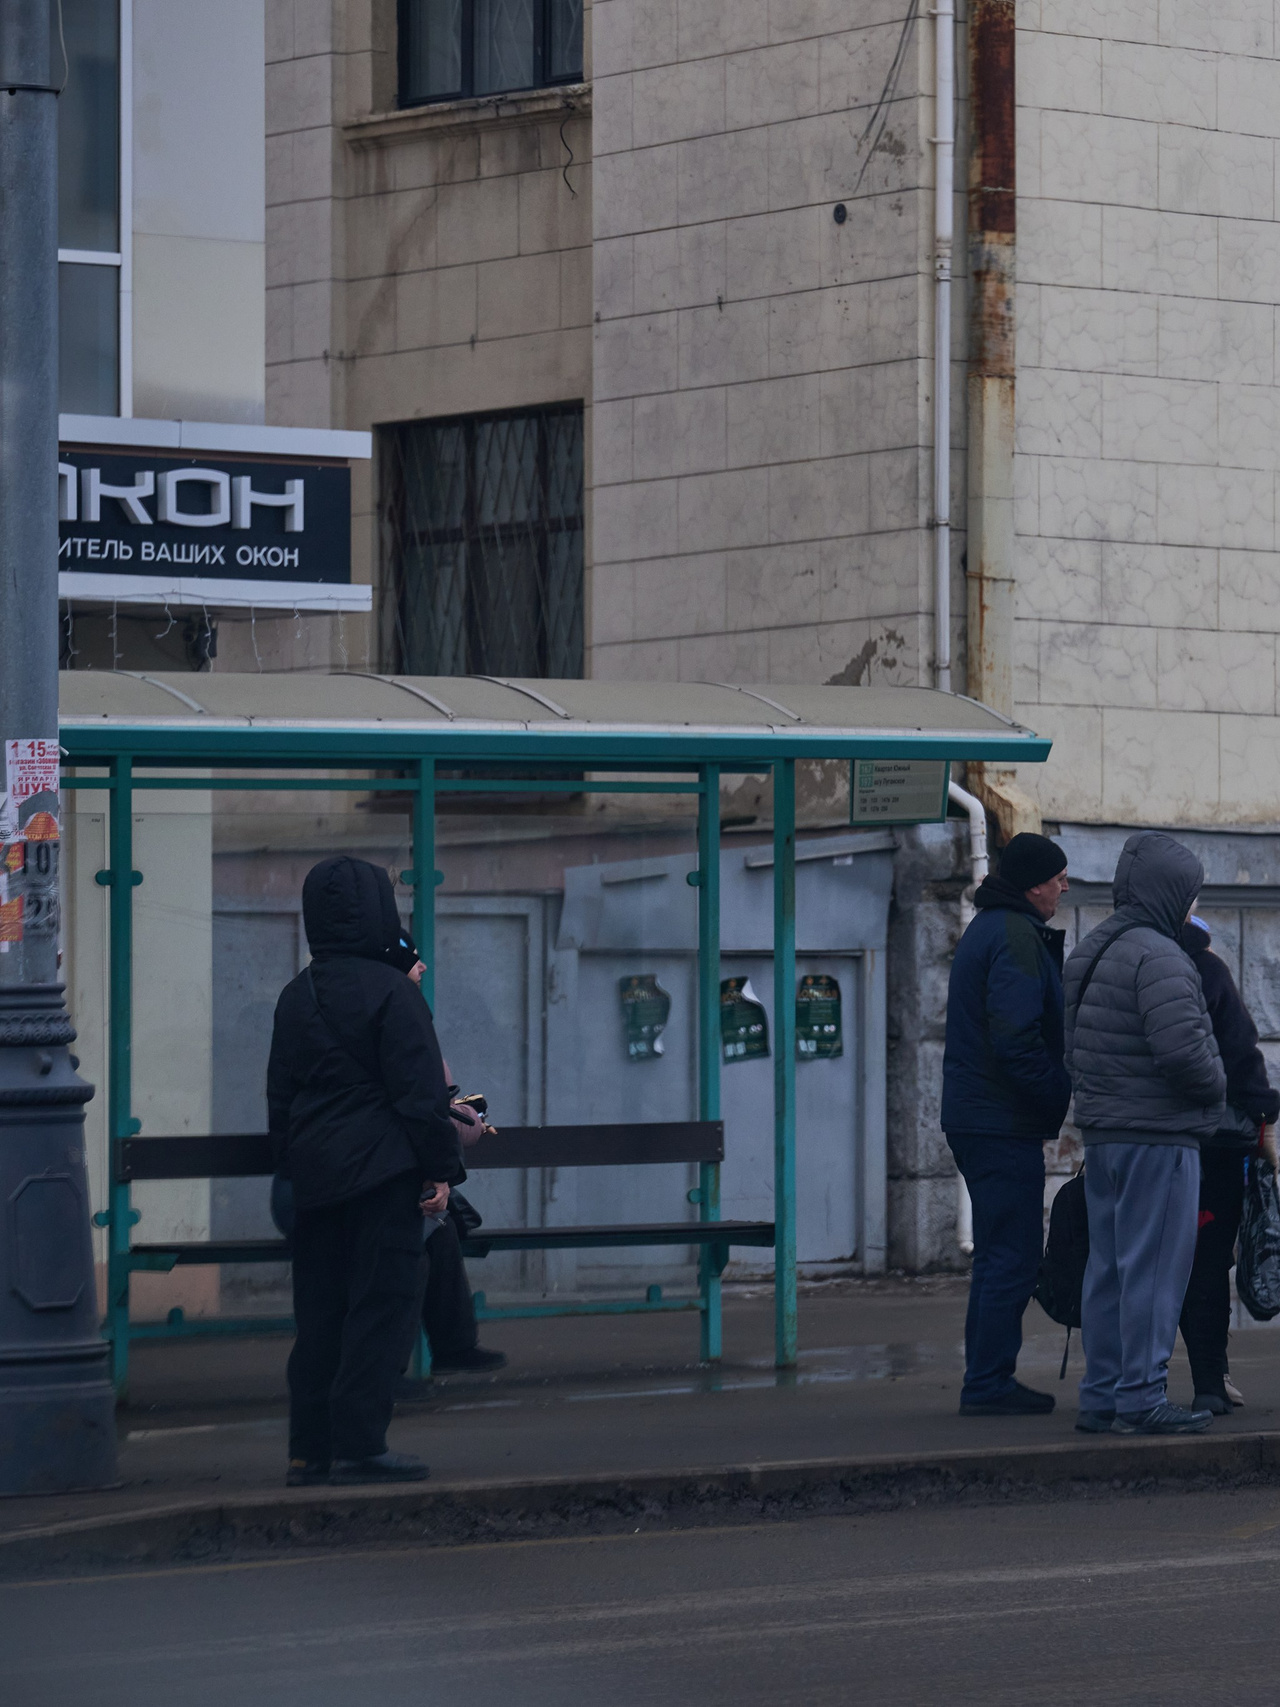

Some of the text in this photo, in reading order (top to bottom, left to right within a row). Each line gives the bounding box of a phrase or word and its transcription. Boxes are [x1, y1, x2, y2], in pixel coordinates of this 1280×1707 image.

[141, 541, 226, 565] ВАШИХ
[235, 545, 299, 568] ОКОН
[27, 741, 46, 757] 15
